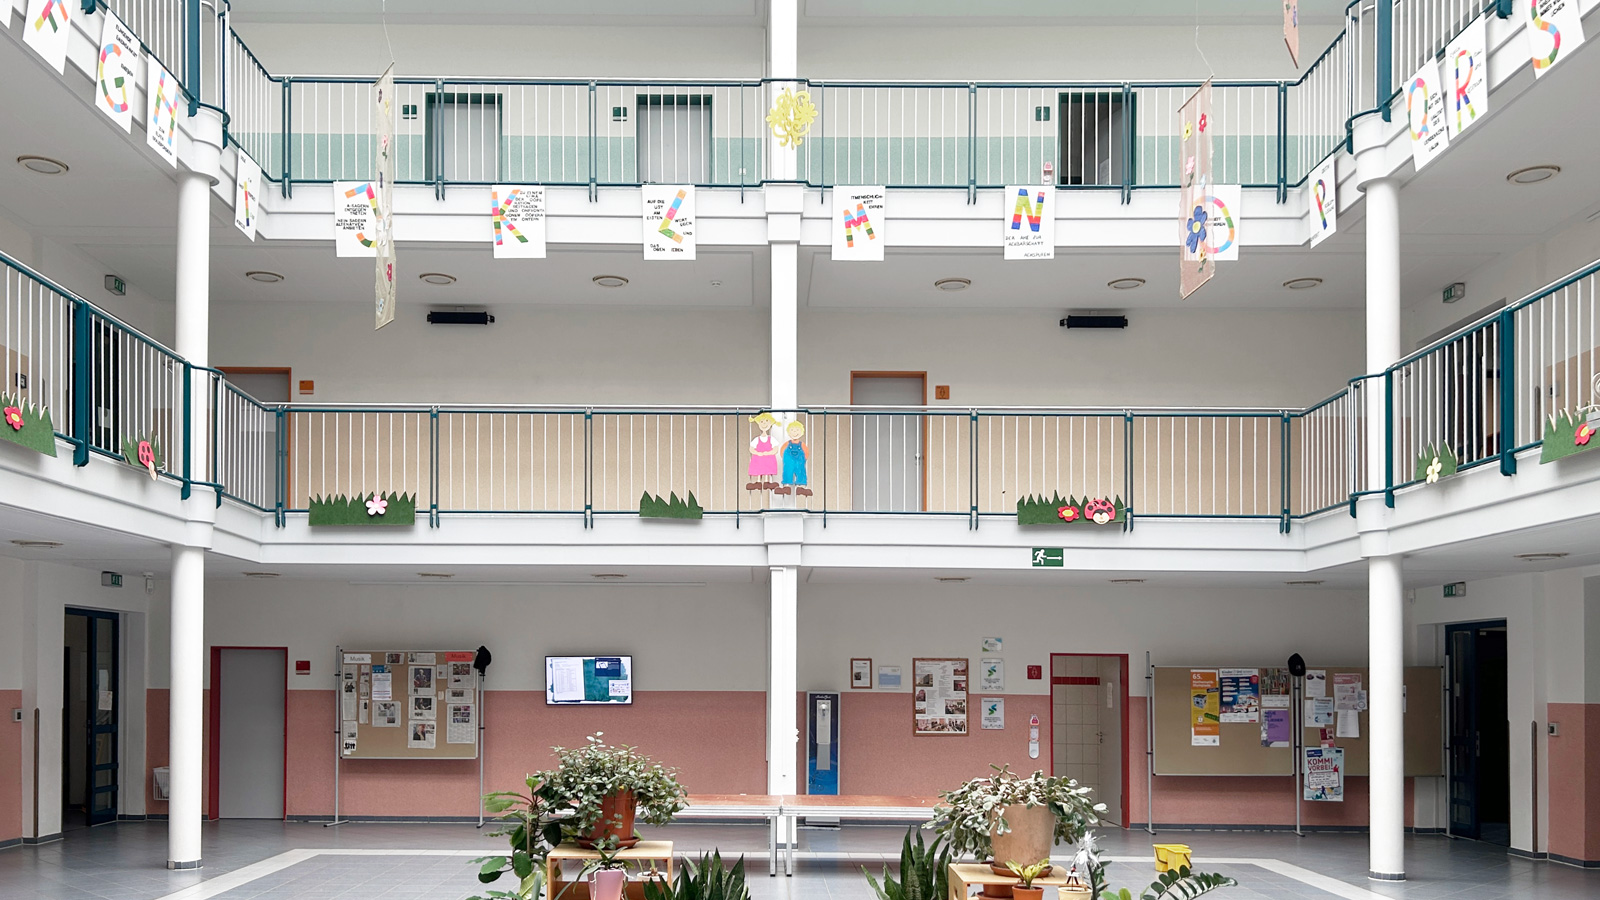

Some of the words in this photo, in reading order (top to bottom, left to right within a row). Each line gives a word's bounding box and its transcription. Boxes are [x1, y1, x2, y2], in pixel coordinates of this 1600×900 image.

[99, 43, 128, 113] G
[153, 66, 178, 147] H
[1455, 49, 1476, 133] R
[1408, 77, 1429, 141] Q
[491, 189, 528, 246] K
[658, 188, 687, 244] L
[843, 203, 876, 248] M
[1011, 188, 1045, 232] N
[1313, 179, 1328, 230] P
